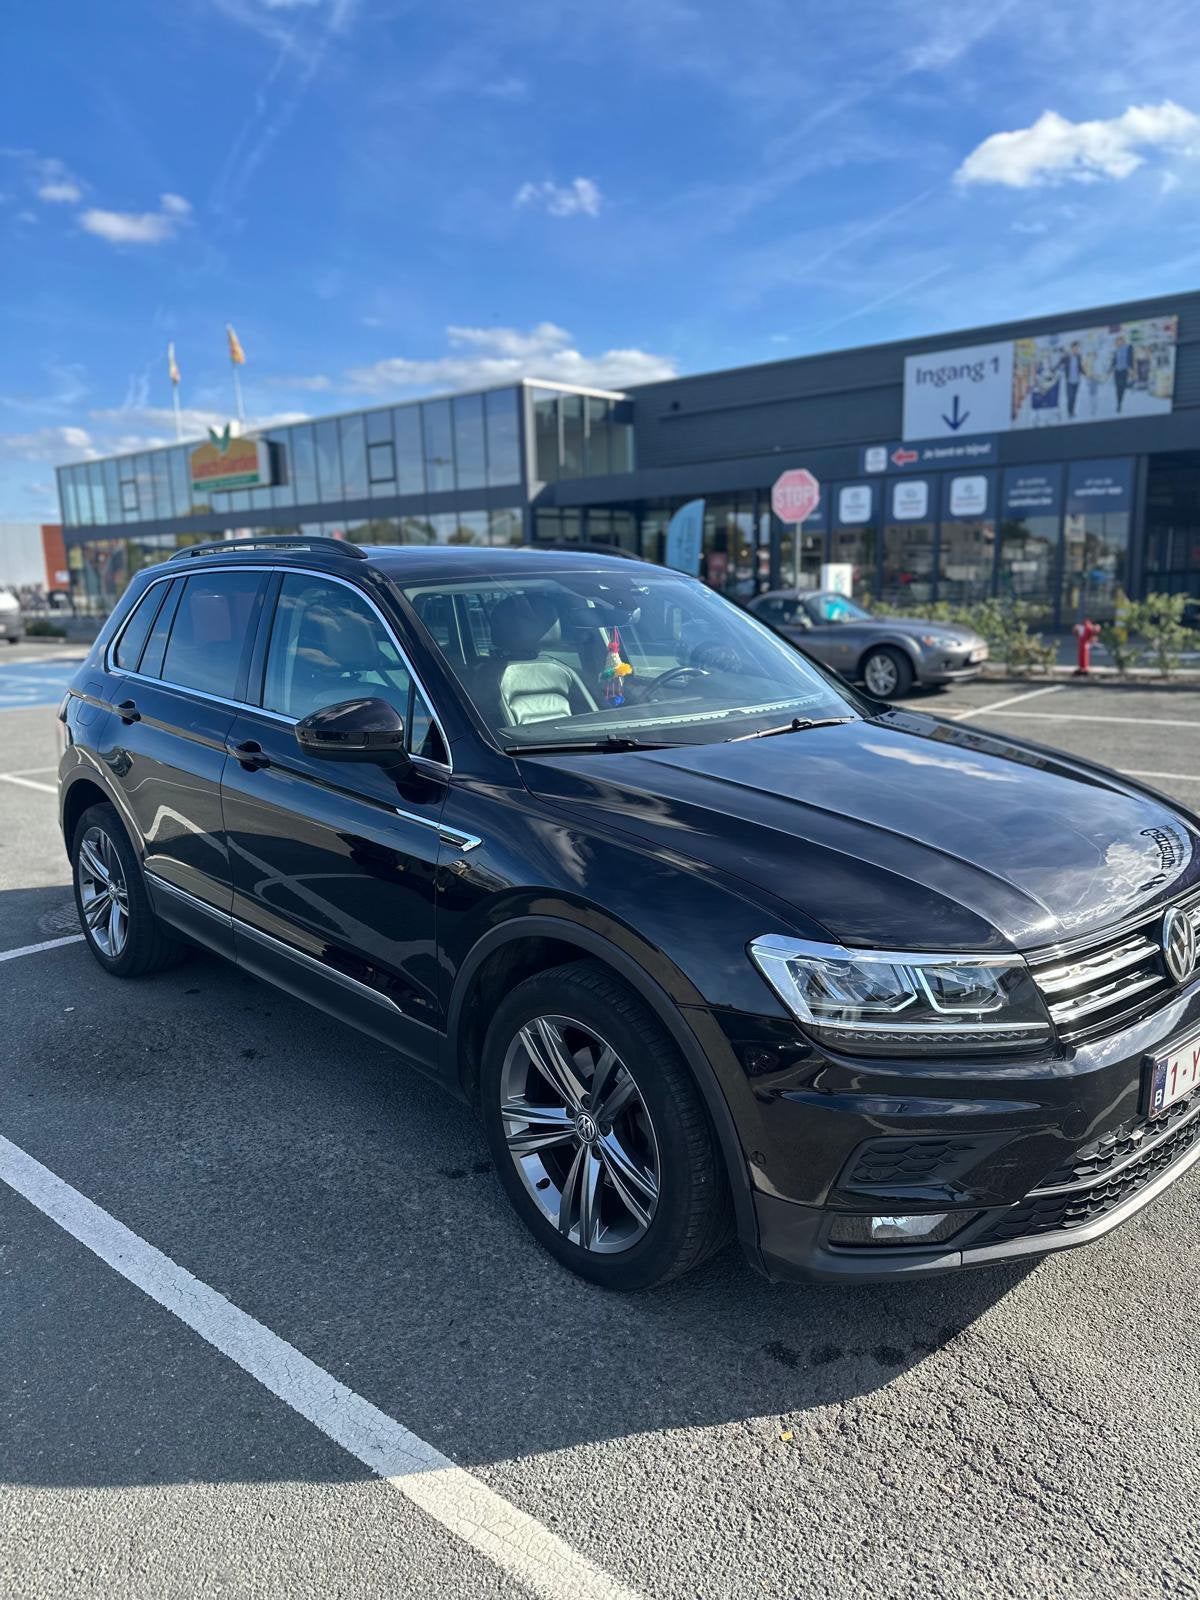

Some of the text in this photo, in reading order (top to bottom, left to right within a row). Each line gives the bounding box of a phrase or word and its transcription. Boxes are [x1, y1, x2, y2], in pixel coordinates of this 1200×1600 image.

[916, 356, 999, 388] Ingang 1
[775, 485, 813, 508] STOP
[1154, 1089, 1163, 1106] B
